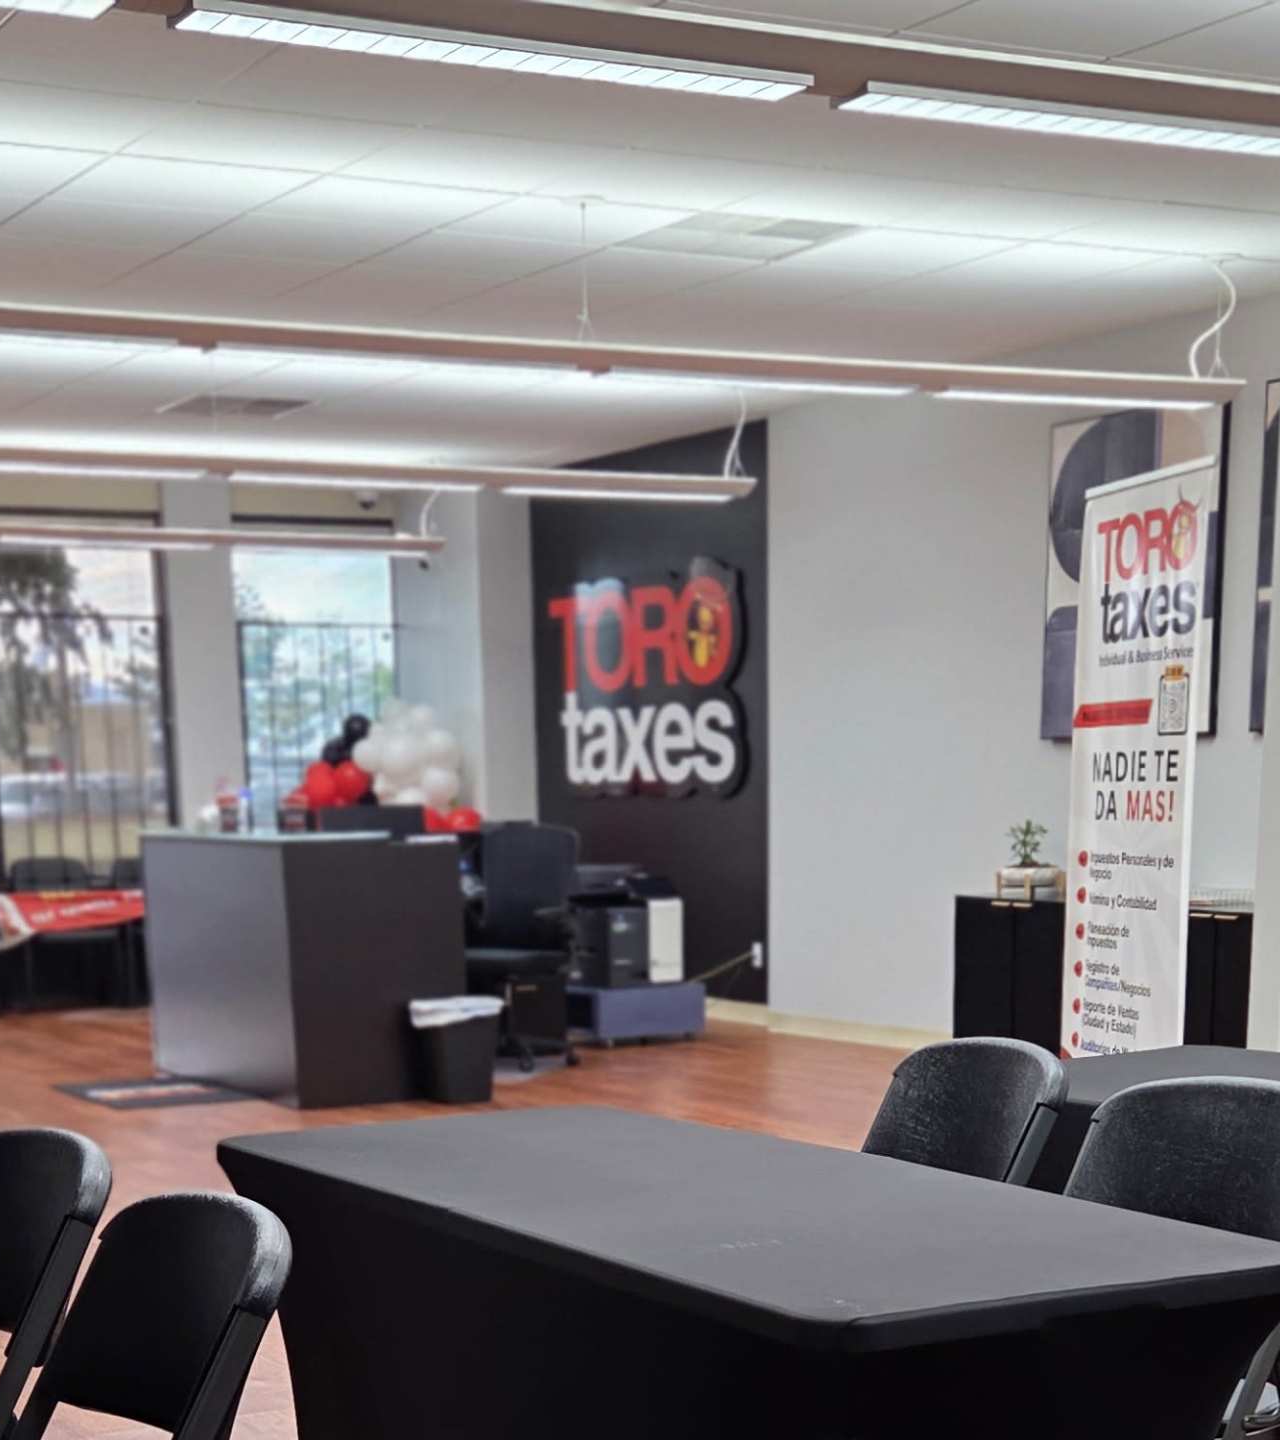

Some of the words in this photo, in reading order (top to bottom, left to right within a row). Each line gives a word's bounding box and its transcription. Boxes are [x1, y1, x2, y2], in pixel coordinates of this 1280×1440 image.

[1097, 499, 1199, 584] TORO
[548, 576, 733, 693] TORO
[1100, 580, 1198, 645] taxes
[560, 692, 737, 784] taxes
[1092, 750, 1147, 783] NADIE
[1155, 749, 1180, 782] TE
[1095, 790, 1118, 821] DA
[1125, 789, 1175, 822] MAS!
[1163, 854, 1175, 869] de
